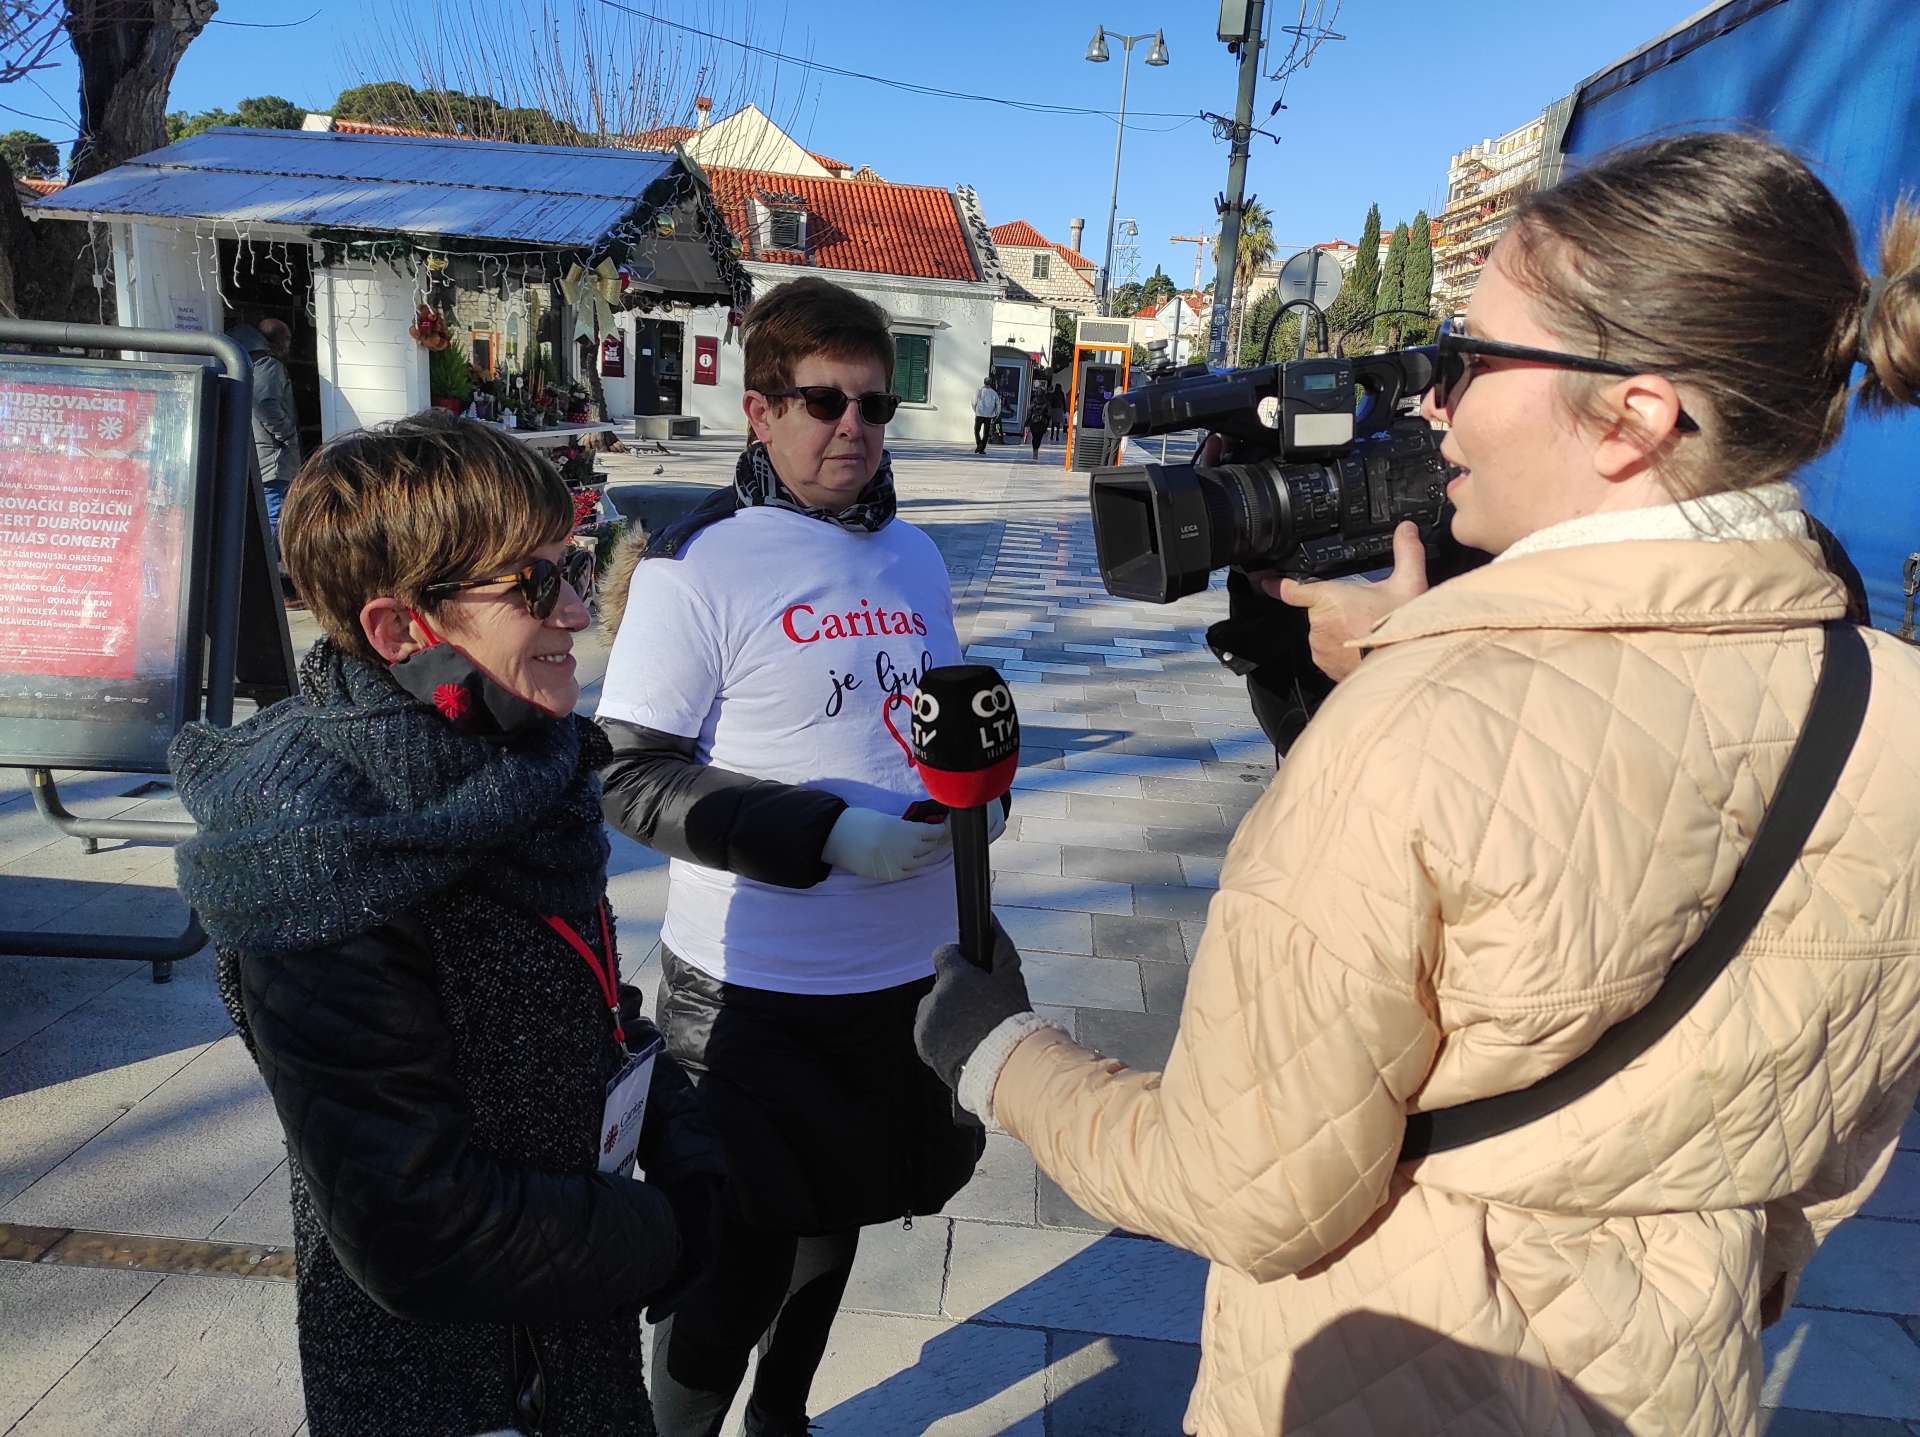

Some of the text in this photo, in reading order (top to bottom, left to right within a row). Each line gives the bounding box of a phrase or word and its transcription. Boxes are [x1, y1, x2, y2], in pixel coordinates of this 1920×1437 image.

[37, 516, 129, 533] DUBROVNIK
[50, 533, 120, 549] CONCERT
[55, 563, 104, 573] ORCHESTRA
[781, 598, 928, 645] Caritas
[825, 669, 864, 717] je
[979, 712, 1016, 749] LTV
